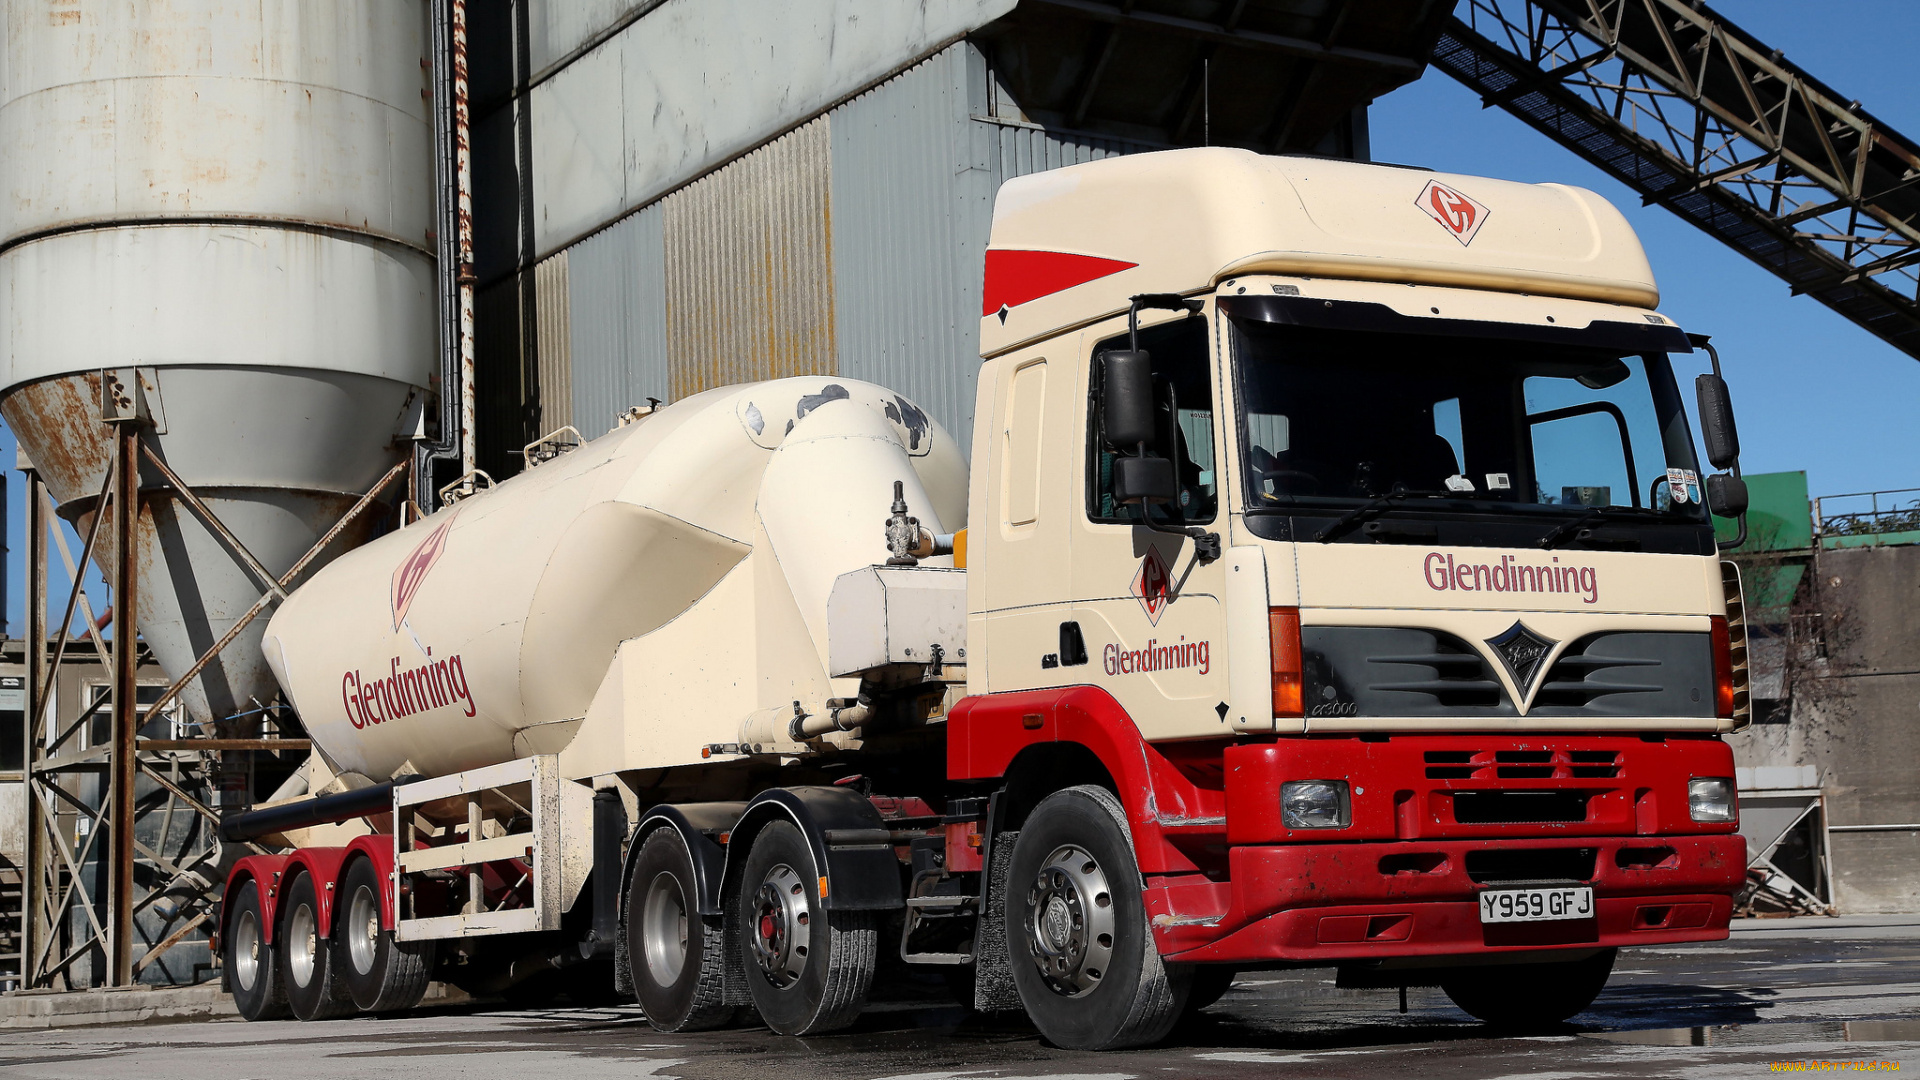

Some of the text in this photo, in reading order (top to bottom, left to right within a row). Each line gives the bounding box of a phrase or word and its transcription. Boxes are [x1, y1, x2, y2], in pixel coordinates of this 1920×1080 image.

[1423, 552, 1598, 604] Glendinning
[1103, 635, 1210, 675] Glendinning
[342, 646, 477, 730] Glendinning
[1483, 890, 1590, 918] Y959 GFJ
